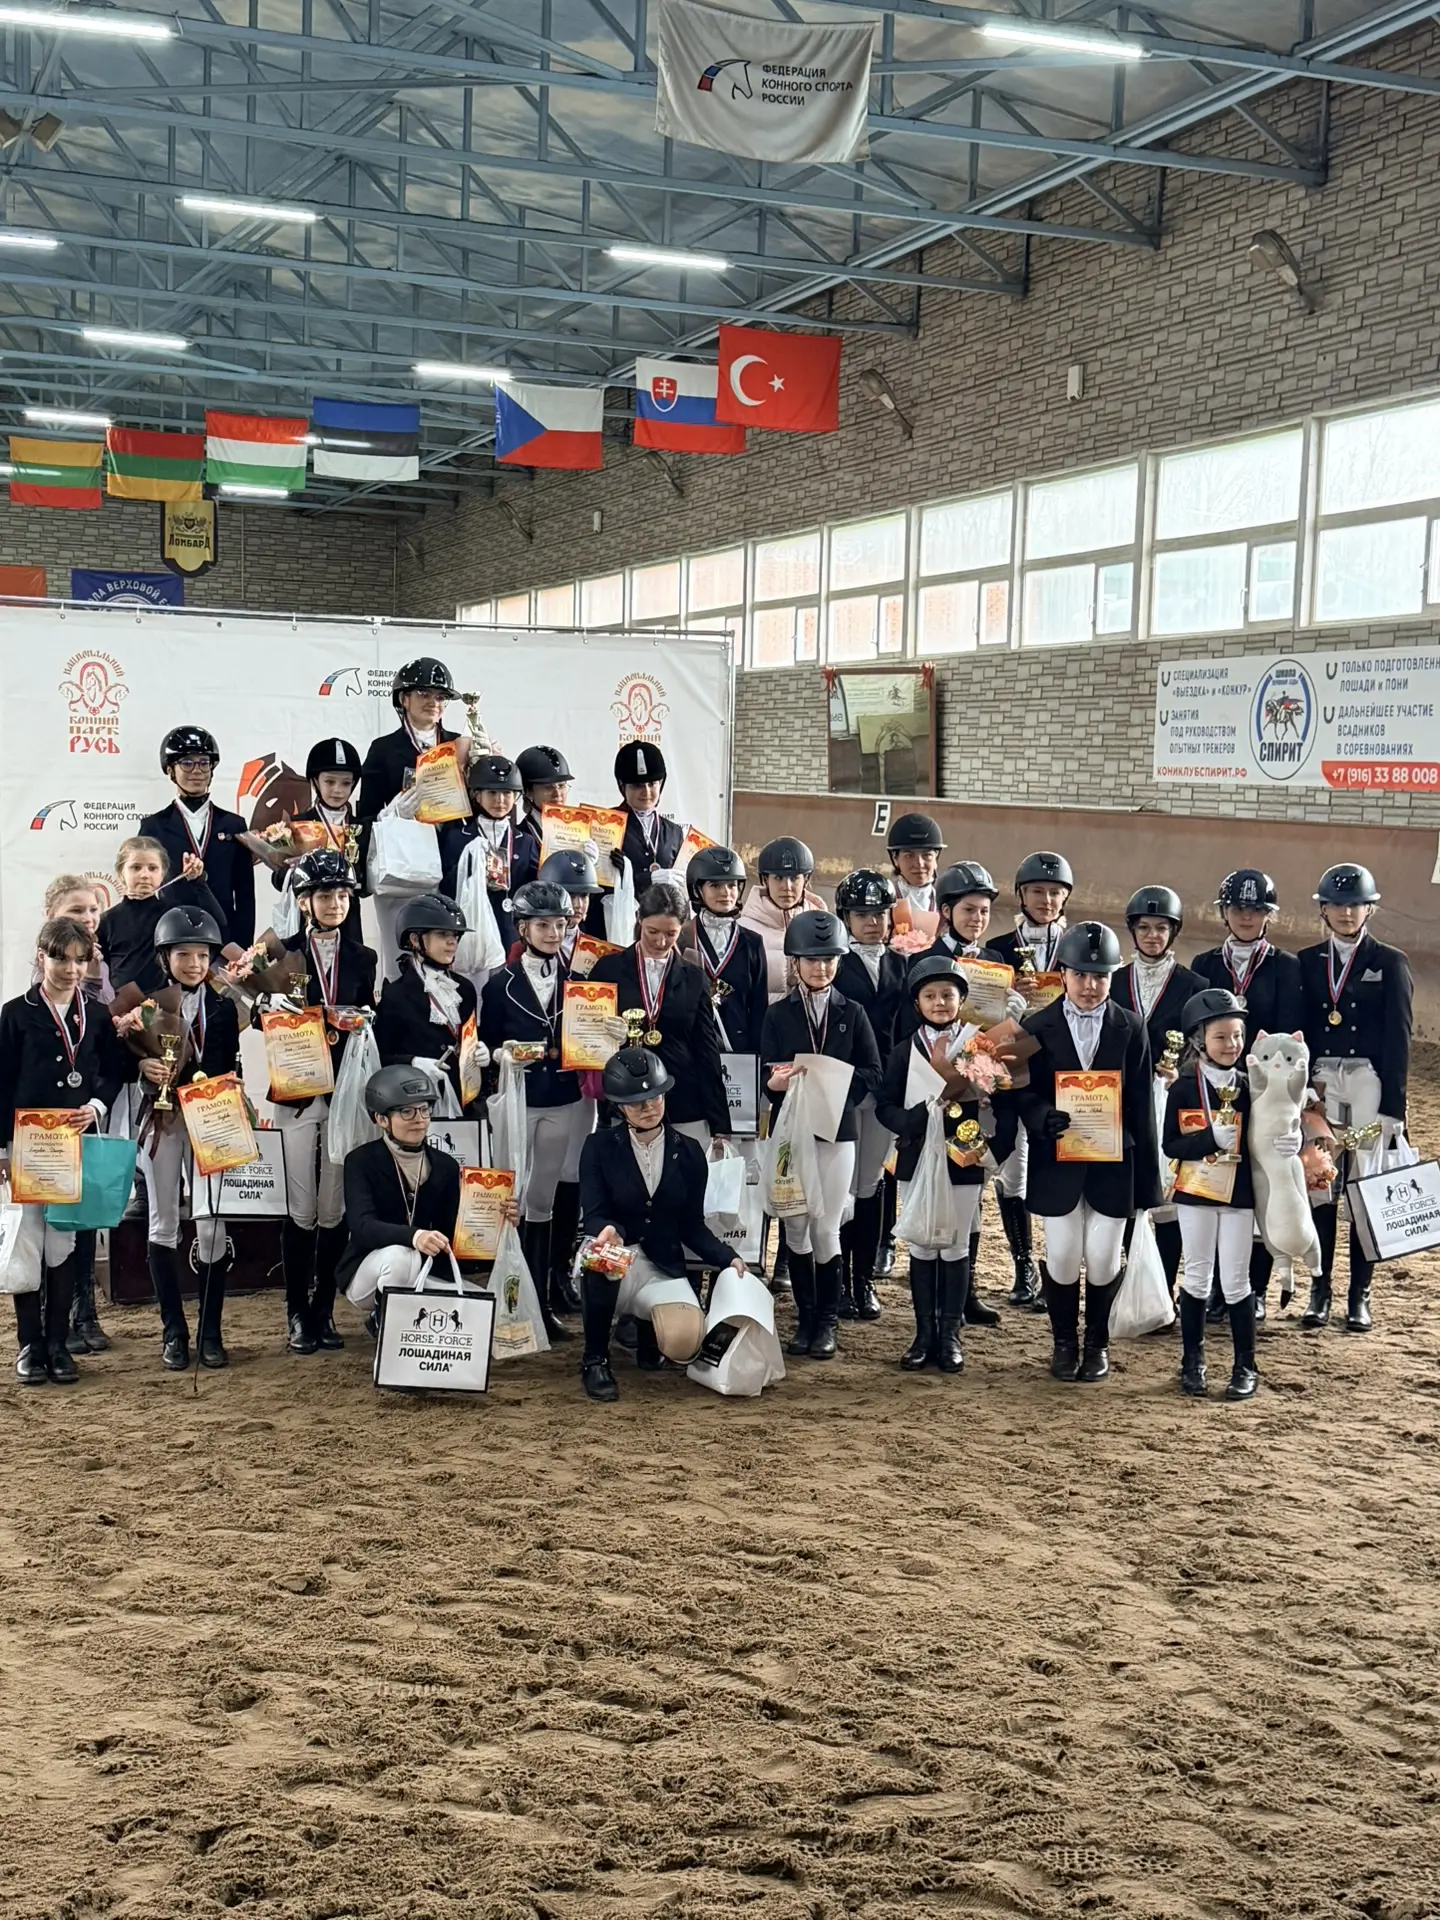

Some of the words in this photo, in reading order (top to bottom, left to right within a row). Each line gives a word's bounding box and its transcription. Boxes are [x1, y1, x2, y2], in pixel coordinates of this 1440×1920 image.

[762, 64, 826, 79] ФЕДЕРАЦИЯ
[762, 78, 812, 92] КОННОГО
[815, 81, 854, 92] СПОРТА
[762, 93, 805, 106] РОССИИ
[106, 580, 161, 600] ВЕРХОВОЙ
[1341, 660, 1372, 673] ТОЛЬКО
[1173, 667, 1229, 682] СПЕЦИАЛИЗАЦИЯ
[367, 679, 394, 688] КОННО
[1339, 679, 1376, 692] ЛОШАДИ
[1385, 678, 1409, 691] ПОНИ
[367, 689, 393, 697] РОССИ
[1170, 709, 1199, 720] ЗАНЯТИЯ
[1338, 702, 1394, 719] ДАЛЬНЕЙШЕЕ
[1396, 704, 1434, 717] УЧАСТИЕ
[69, 726, 120, 735] ПАРК
[1170, 725, 1183, 738] ПОД
[1185, 725, 1236, 738] РУКОВОДСТВОМ
[1337, 724, 1386, 738] ВСАДНИКОВ
[69, 735, 120, 754] РУСЬ
[1169, 743, 1201, 754] ОПЫТНЫХ
[1202, 742, 1236, 754] ТРЕНЕРОВ
[1336, 743, 1342, 755] В
[1343, 743, 1413, 755] СОРЕВНОВАНИЯХ
[1259, 742, 1303, 762] СПИРИТ
[1157, 766, 1248, 778] КОНИКЛУБСПИРИТ.РФ
[1332, 768, 1345, 781] +7
[1347, 768, 1372, 785] (916)
[1374, 767, 1389, 783] 33
[1392, 767, 1409, 784] 88
[1411, 767, 1438, 784] 008
[83, 802, 136, 811] ФЕДЕРАЦИЯ
[83, 812, 125, 821] КОННОГО
[874, 804, 888, 833] E
[83, 823, 119, 831] РОССИИ
[279, 1030, 315, 1041] ГРАМОТА
[1070, 1094, 1109, 1102] ГРАМОТА
[197, 1099, 232, 1114] ГРАМОТА
[249, 1166, 273, 1175] FORCE
[223, 1179, 274, 1189] ЛОШАДИНАЯ
[1398, 1186, 1408, 1198] H
[1381, 1205, 1407, 1219] HORSE
[1409, 1197, 1437, 1211] FORCE
[1386, 1209, 1440, 1231] ЛОШАДИНАЯ
[432, 1315, 444, 1327] H
[400, 1333, 434, 1344] HORSE
[439, 1335, 473, 1346] FORCE
[398, 1347, 472, 1361] ЛОШАДИНАЯ
